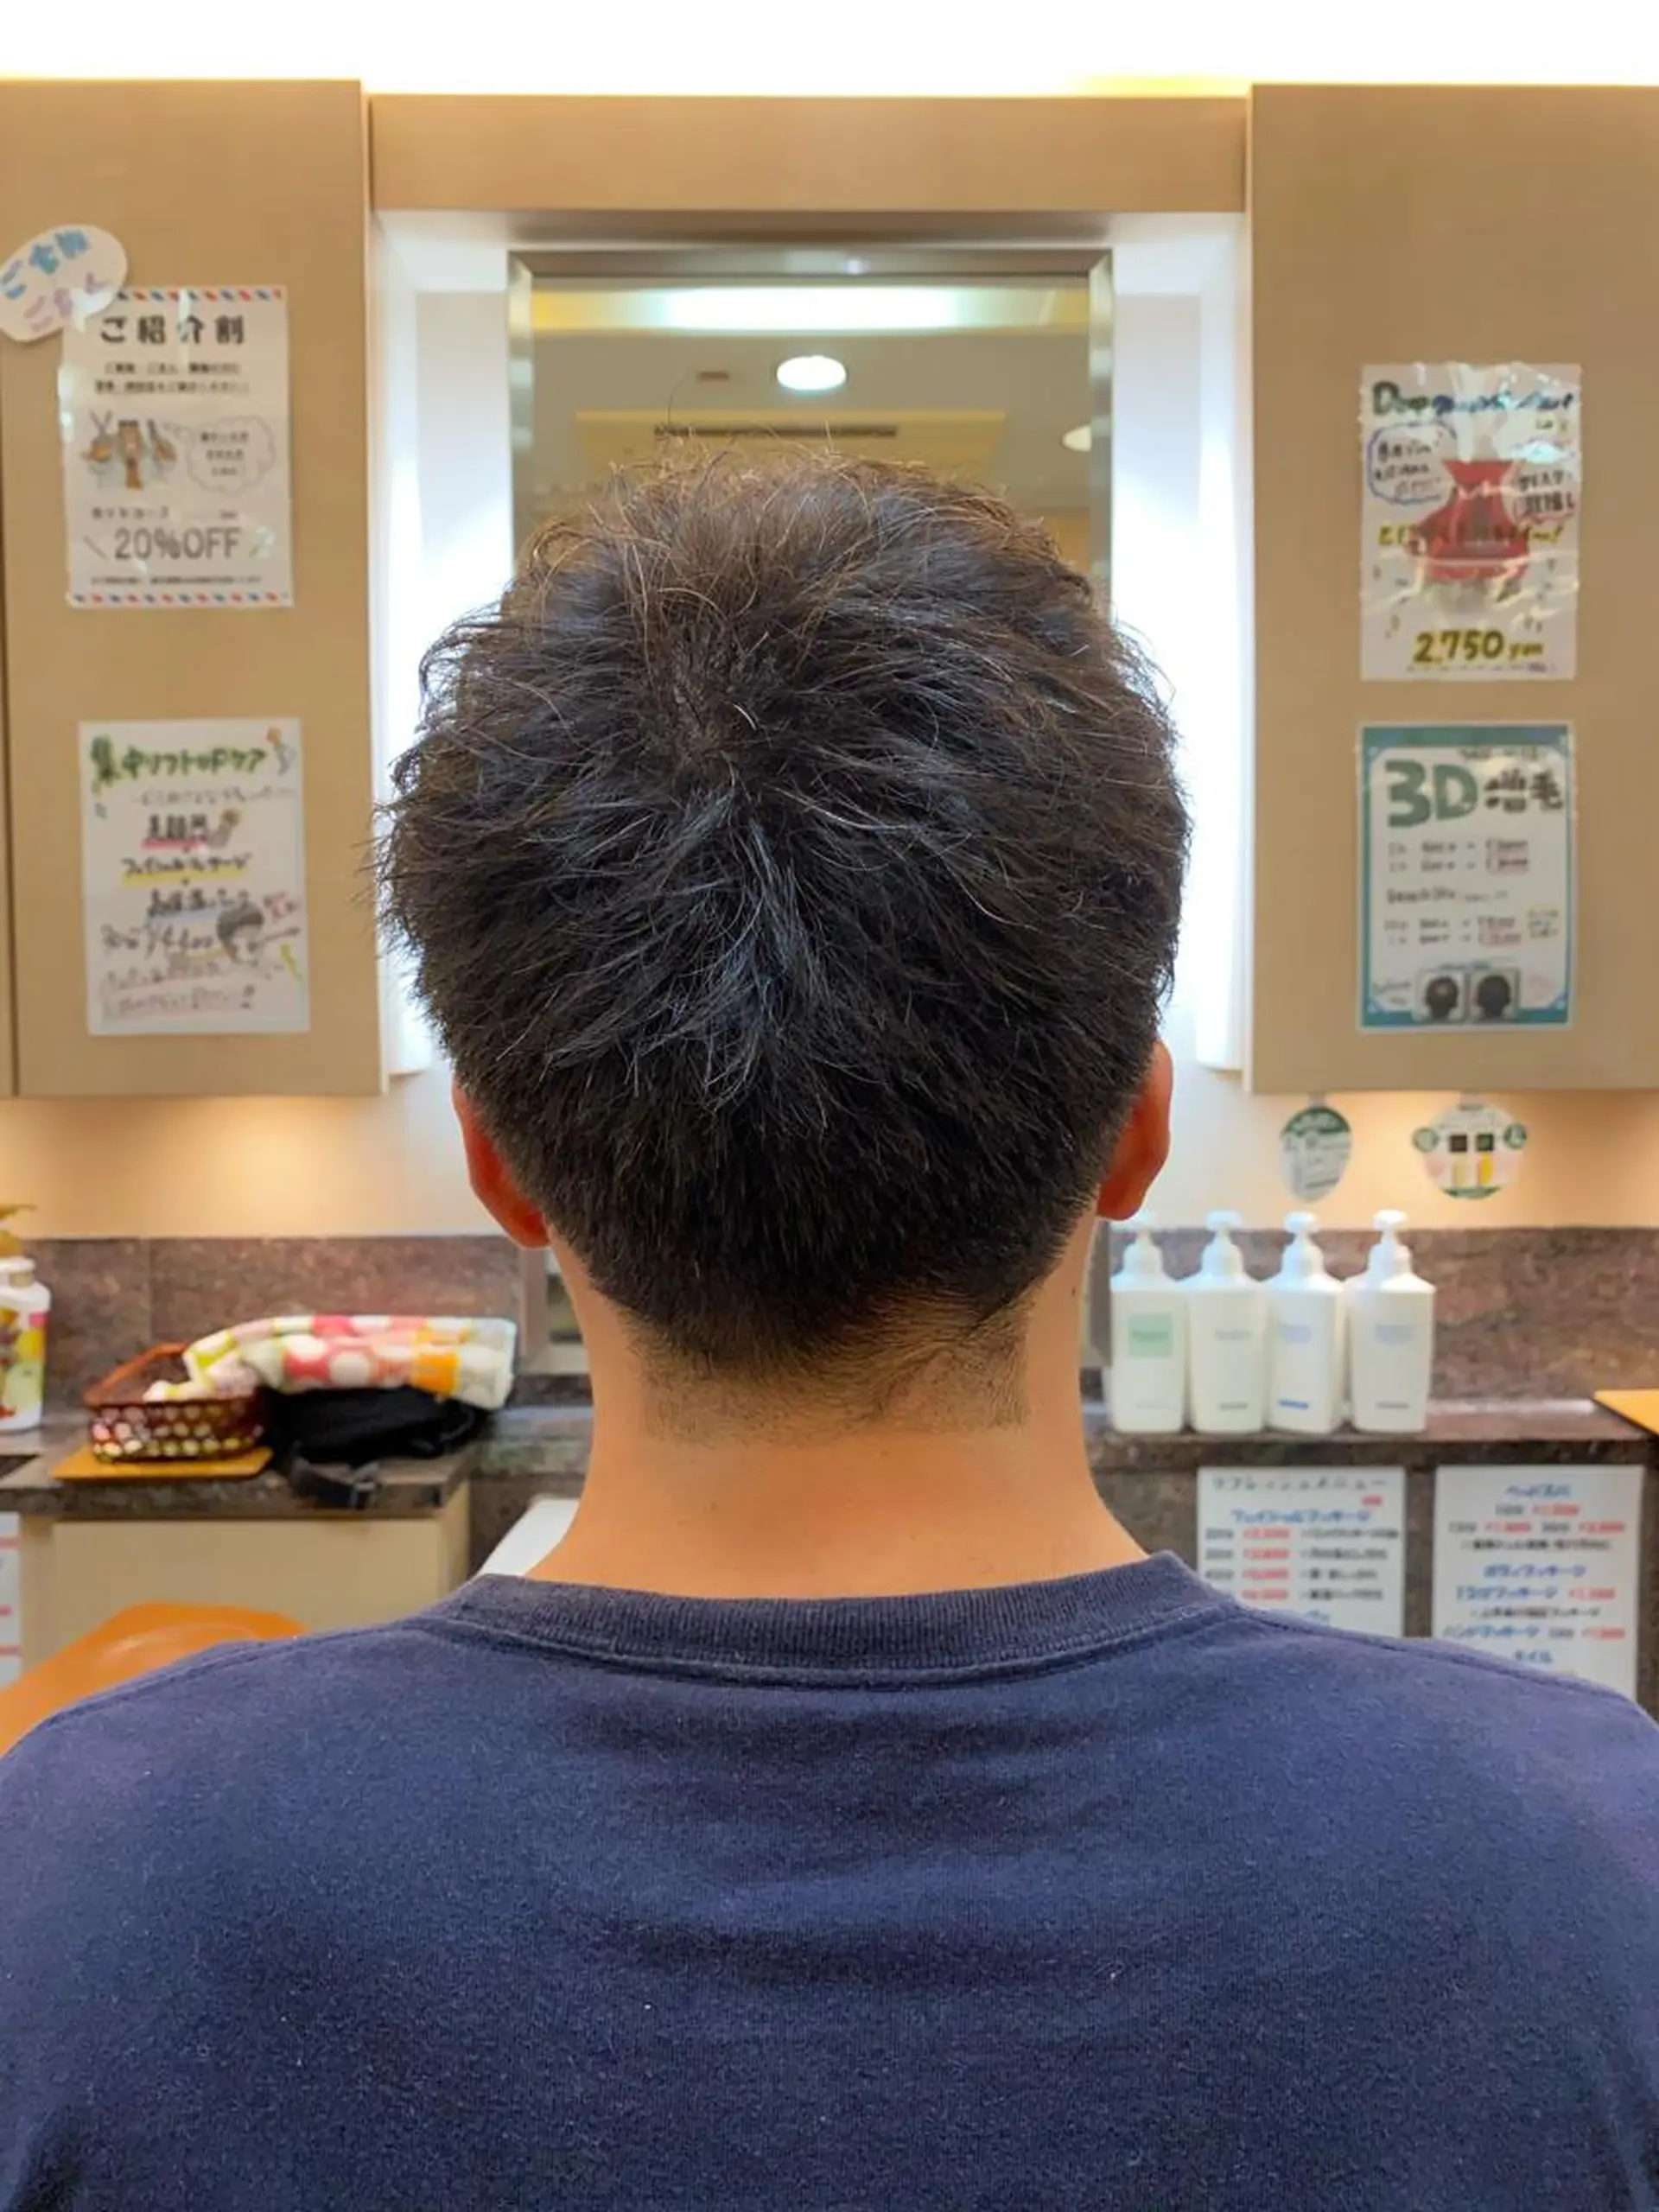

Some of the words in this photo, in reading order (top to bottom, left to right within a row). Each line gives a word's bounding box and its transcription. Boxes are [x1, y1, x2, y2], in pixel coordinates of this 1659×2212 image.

[100, 315, 244, 344] ご紹介割
[114, 526, 240, 560] 20%OFF
[1414, 630, 1504, 663] 2,750
[1385, 760, 1478, 828] 3D
